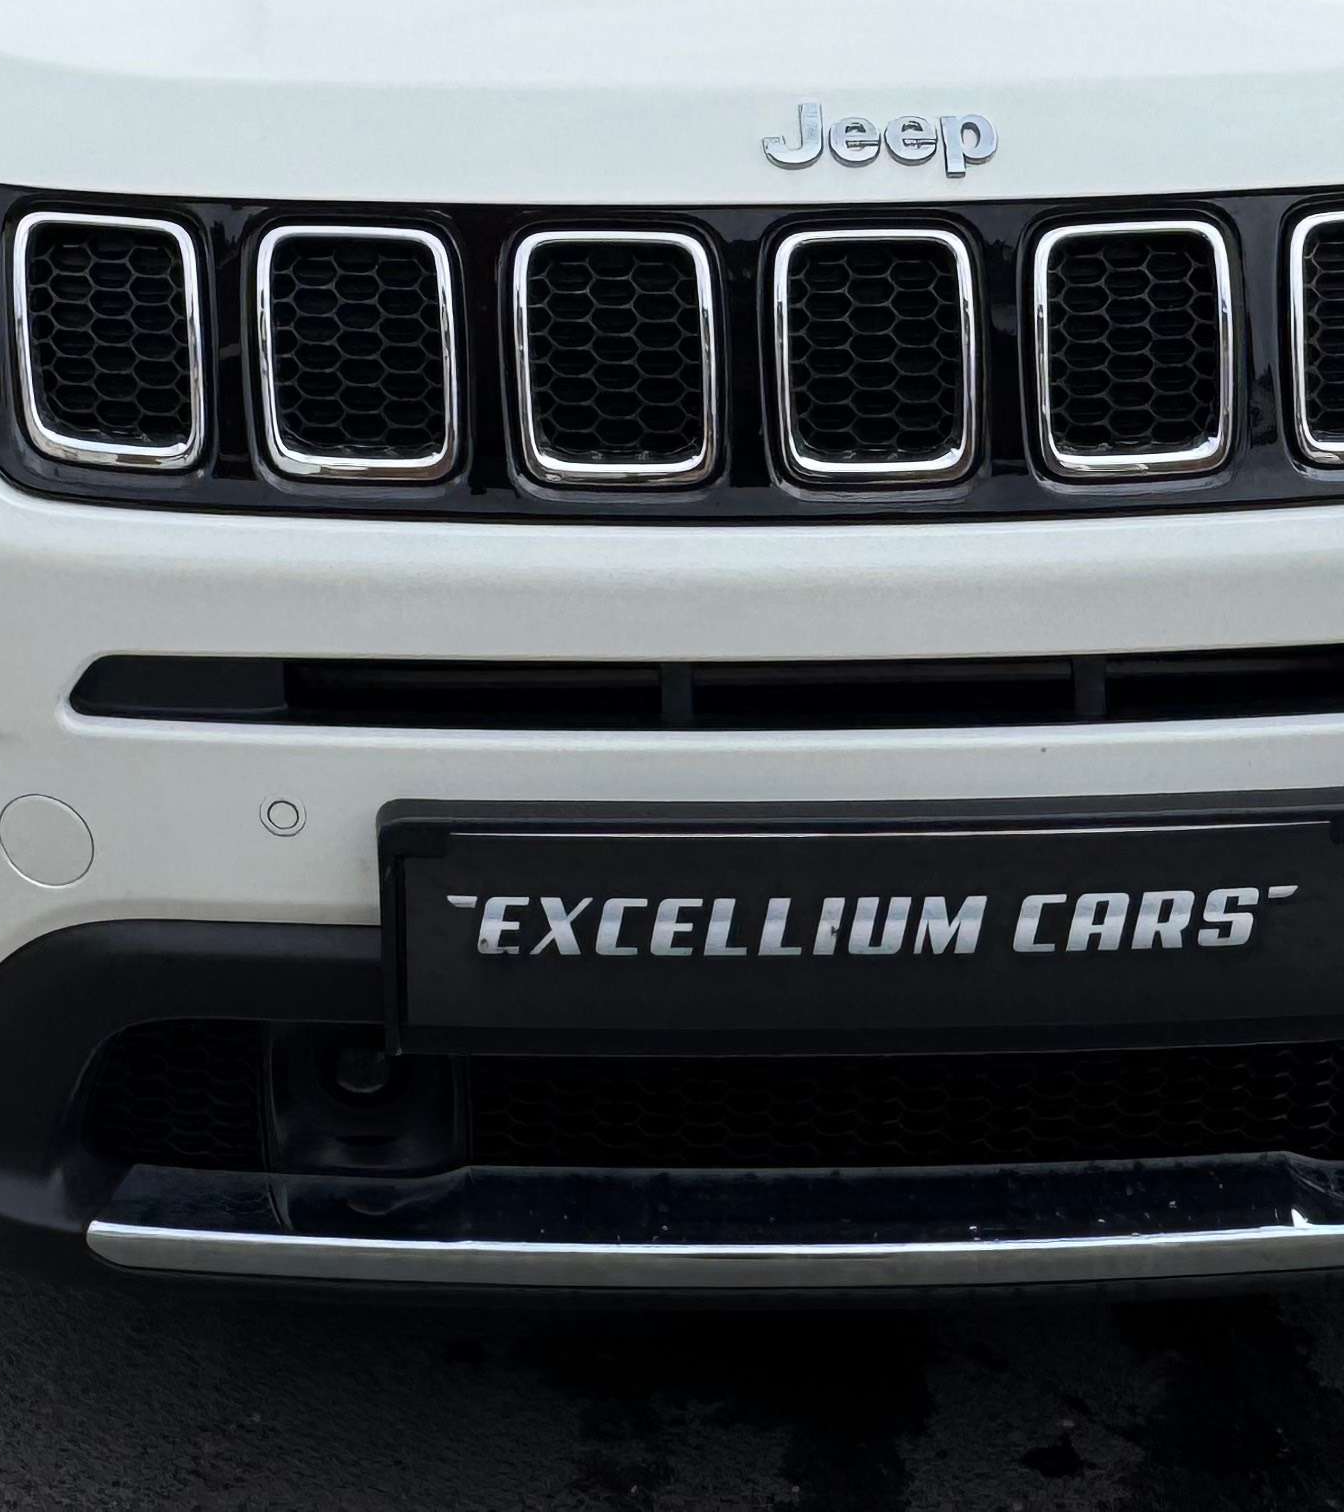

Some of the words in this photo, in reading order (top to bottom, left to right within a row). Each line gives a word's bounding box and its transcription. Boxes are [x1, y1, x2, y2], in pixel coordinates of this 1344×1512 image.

[761, 103, 999, 178] Jeep
[477, 894, 984, 957] EXCELLIUM
[1011, 888, 1258, 951] CARS
